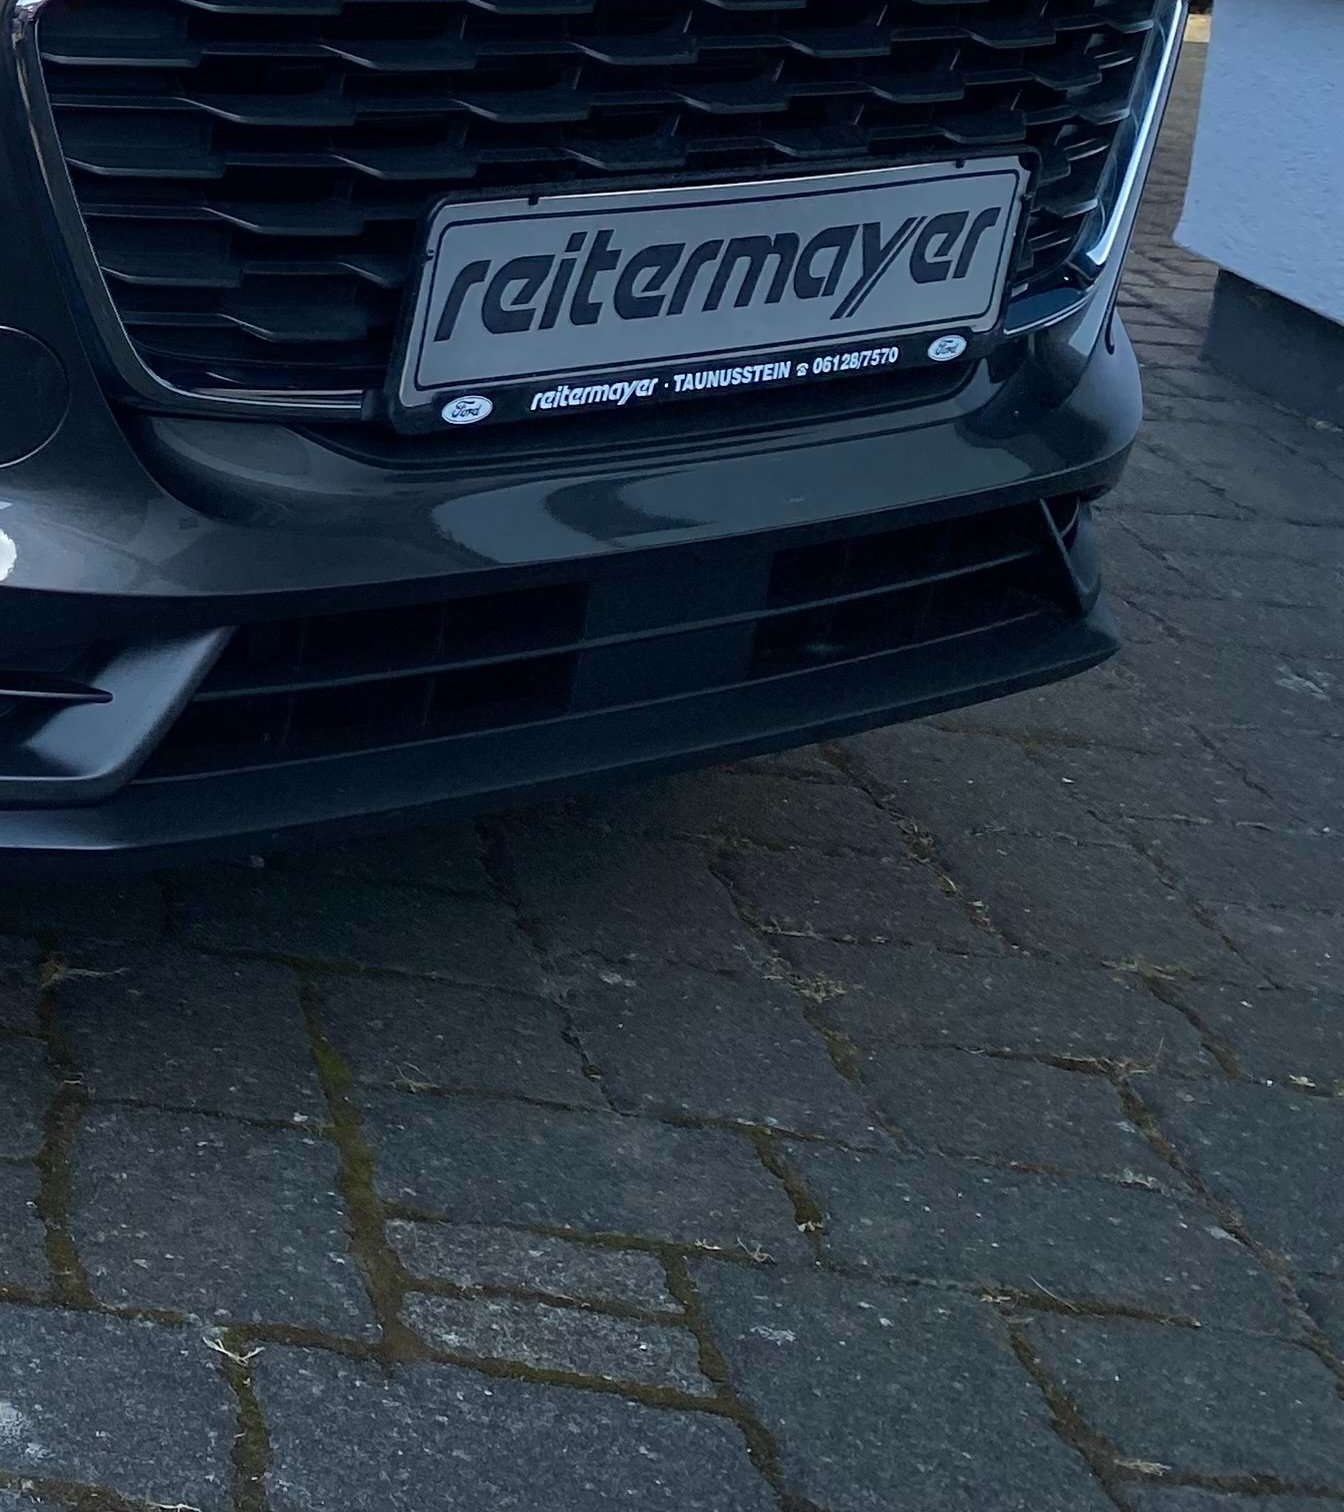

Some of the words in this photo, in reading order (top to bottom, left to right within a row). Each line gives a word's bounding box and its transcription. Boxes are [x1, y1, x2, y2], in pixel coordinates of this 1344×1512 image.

[433, 206, 1002, 342] reitermayer
[529, 377, 660, 411] reitermayer
[673, 360, 792, 393] TAUNUSSTEIN
[812, 346, 900, 375] 06128/7570
